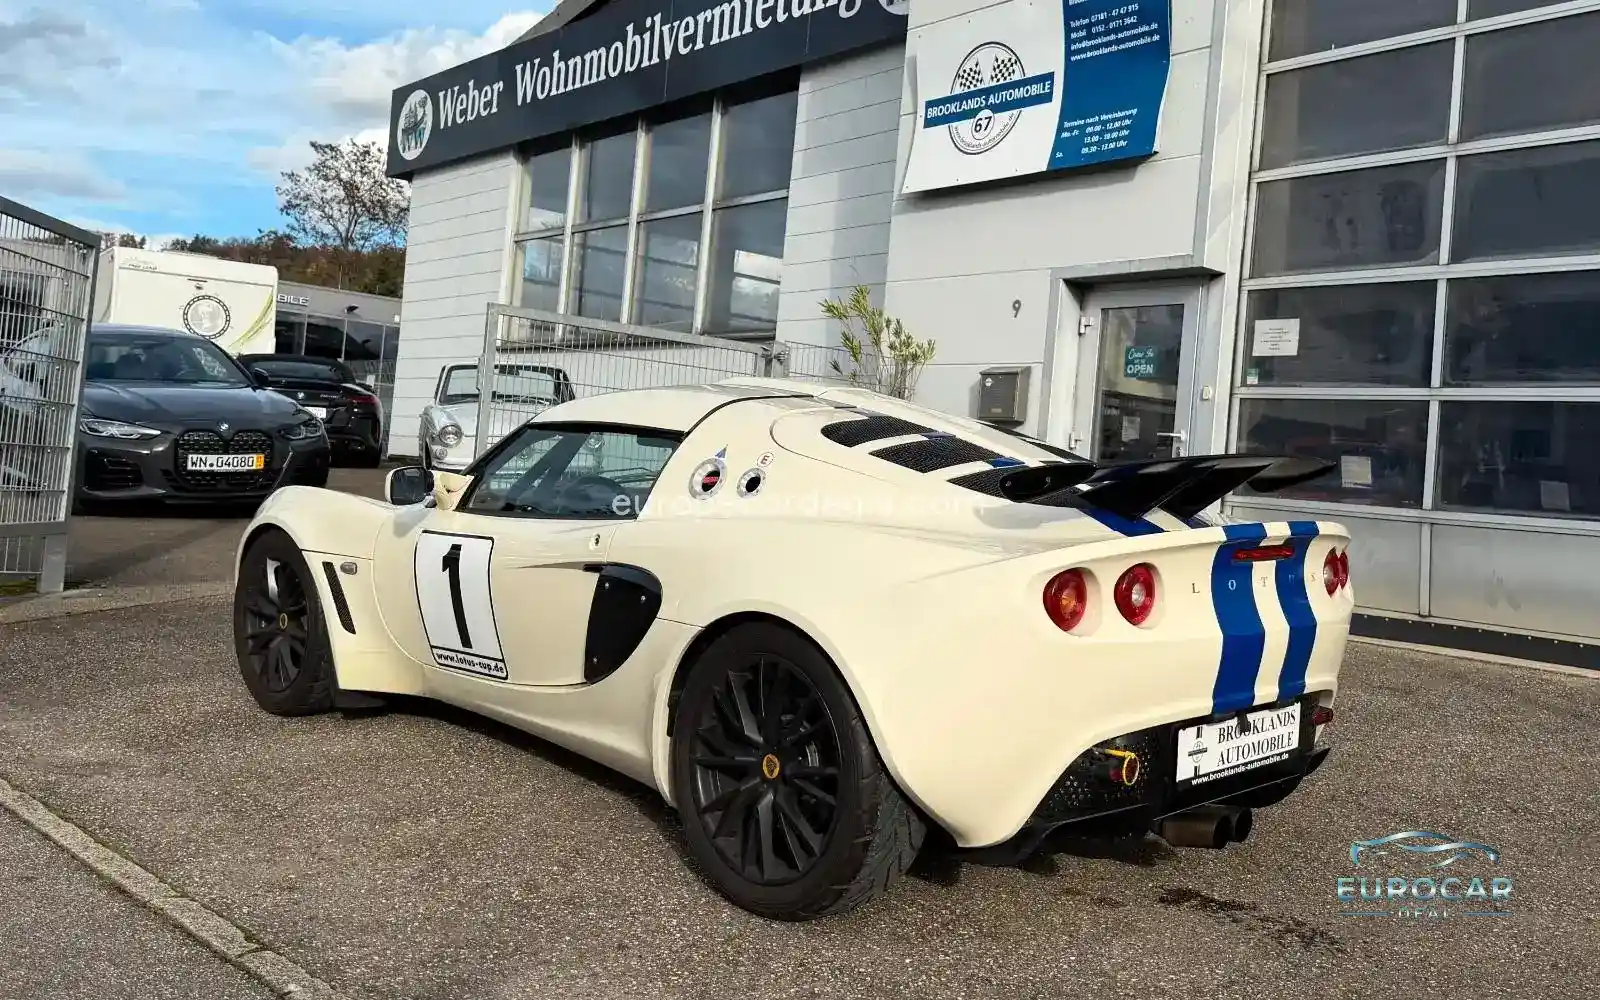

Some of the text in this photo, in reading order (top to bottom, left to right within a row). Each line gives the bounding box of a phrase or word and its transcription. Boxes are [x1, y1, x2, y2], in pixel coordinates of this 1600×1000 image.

[1070, 18, 1090, 28] Telefon
[1071, 29, 1087, 39] Mobil
[1071, 22, 1158, 50] info@brooklands-automobile.de
[1071, 34, 1160, 61] www.brooklands-automobile.de
[438, 77, 503, 129] Weber
[927, 81, 1050, 119] BROOKLANDS AUTOMOBILE
[974, 116, 992, 133] 67
[1064, 108, 1137, 128] Termine nach Vereinbarung
[1119, 129, 1130, 137] Uhr
[1116, 140, 1128, 148] Uhr
[1011, 299, 1022, 319] 9
[1127, 363, 1153, 374] OPEN
[191, 456, 207, 468] WN
[760, 455, 770, 465] E
[441, 543, 473, 649] 1
[436, 651, 504, 674] www.lotus-cup.de
[1217, 732, 1294, 767] AUTOMOBILE
[1192, 753, 1288, 785] www.brooklands-automobile.de
